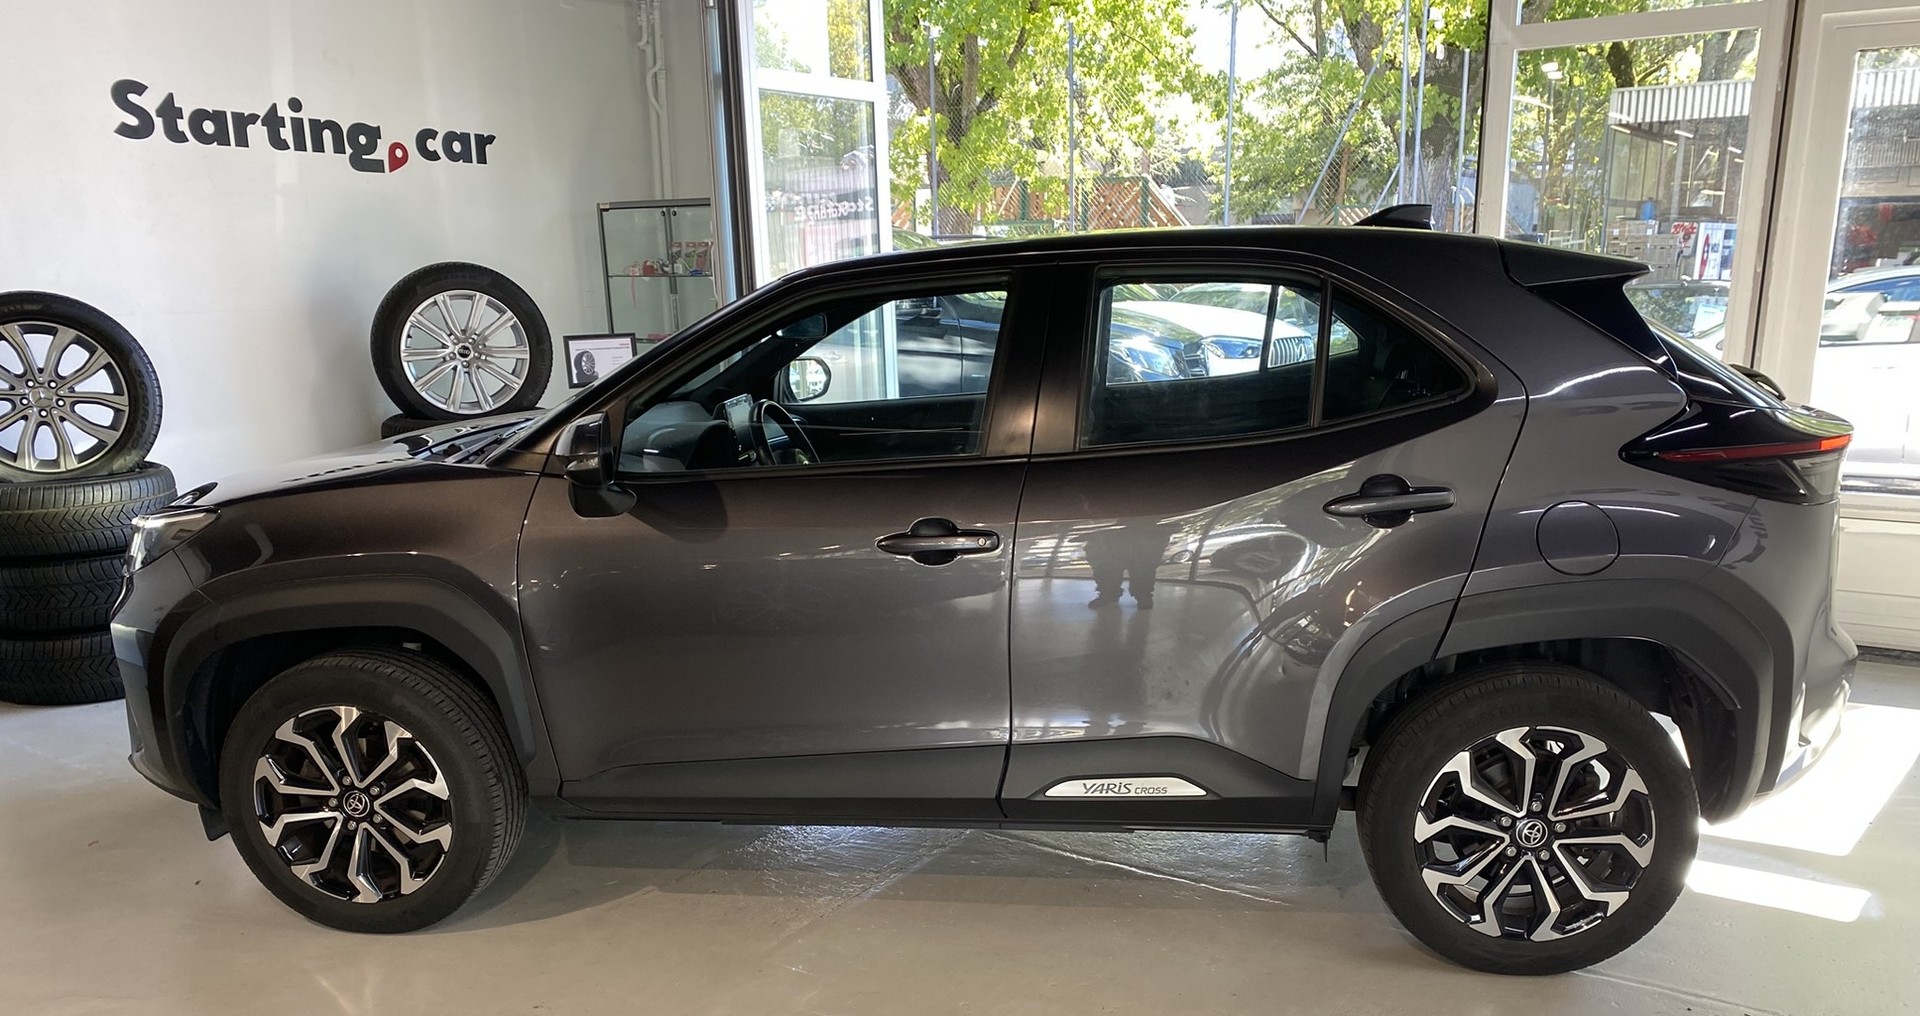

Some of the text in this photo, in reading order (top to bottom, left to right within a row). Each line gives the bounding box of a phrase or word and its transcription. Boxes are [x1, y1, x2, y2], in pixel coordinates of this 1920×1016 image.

[110, 78, 497, 173] Starting car
[128, 368, 149, 456] SCORPIO
[1134, 786, 1168, 795] CROSS
